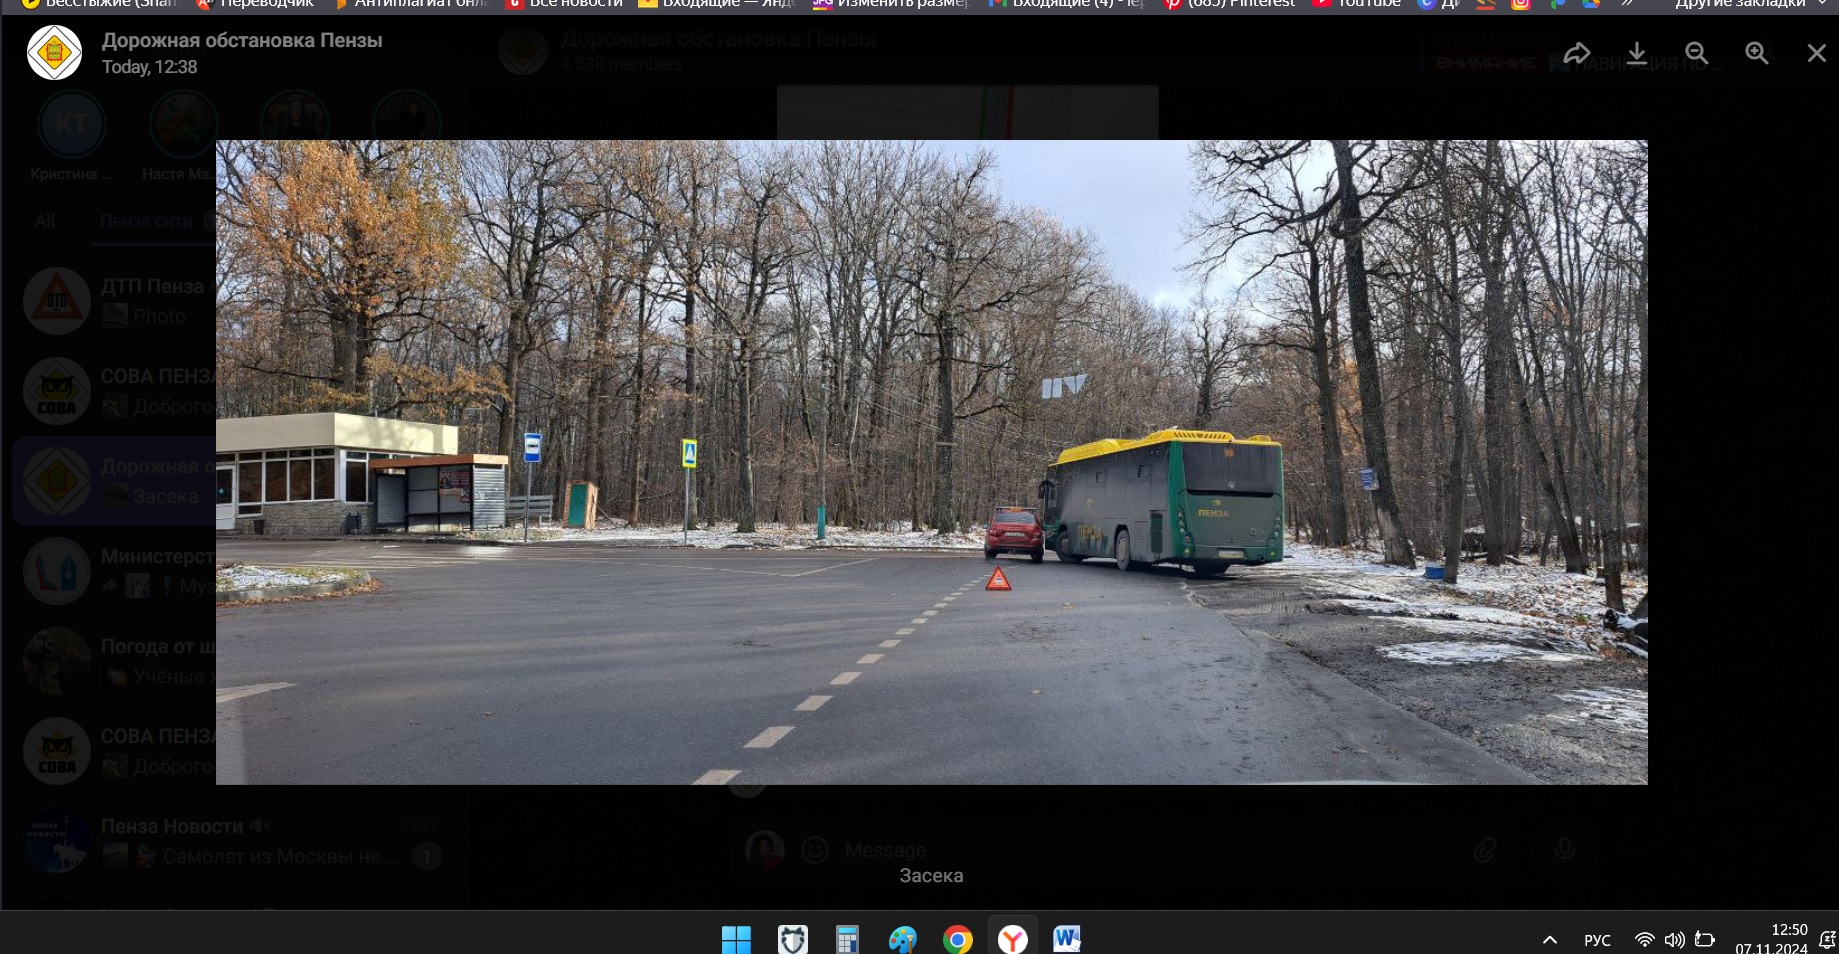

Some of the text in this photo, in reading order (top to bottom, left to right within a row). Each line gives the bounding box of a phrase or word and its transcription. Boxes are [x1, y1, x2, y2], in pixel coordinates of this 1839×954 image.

[1736, 0, 1806, 9] закладки
[102, 31, 383, 51] Дорожная обстановка Пензы
[102, 59, 197, 77] Today, 12:38
[31, 167, 98, 181] Кристина
[143, 167, 184, 180] Настя
[35, 213, 55, 228] All
[101, 278, 204, 297] ДТП Пенза
[134, 308, 187, 324] Photo
[101, 368, 155, 384] СОВА
[133, 397, 213, 418] Доброго
[101, 458, 199, 478] Дорожная
[133, 488, 199, 504] Засека
[1198, 508, 1230, 518] ПЕНЗА
[102, 548, 216, 568] Министерст
[101, 639, 168, 658] Погода
[173, 642, 195, 654] от
[134, 668, 205, 687] Учёные
[101, 728, 155, 744] СОВА
[133, 757, 213, 778] Доброго
[101, 818, 244, 834] Пенза Новости
[163, 848, 246, 865] Самолет
[250, 851, 272, 864] из
[278, 848, 353, 864] Москвы
[359, 851, 381, 864] не
[846, 842, 927, 862] Message
[899, 867, 964, 883] Засека
[1772, 923, 1808, 936] 12:50
[1585, 934, 1611, 947] РУС
[1735, 943, 1809, 954] 07.11.2024
